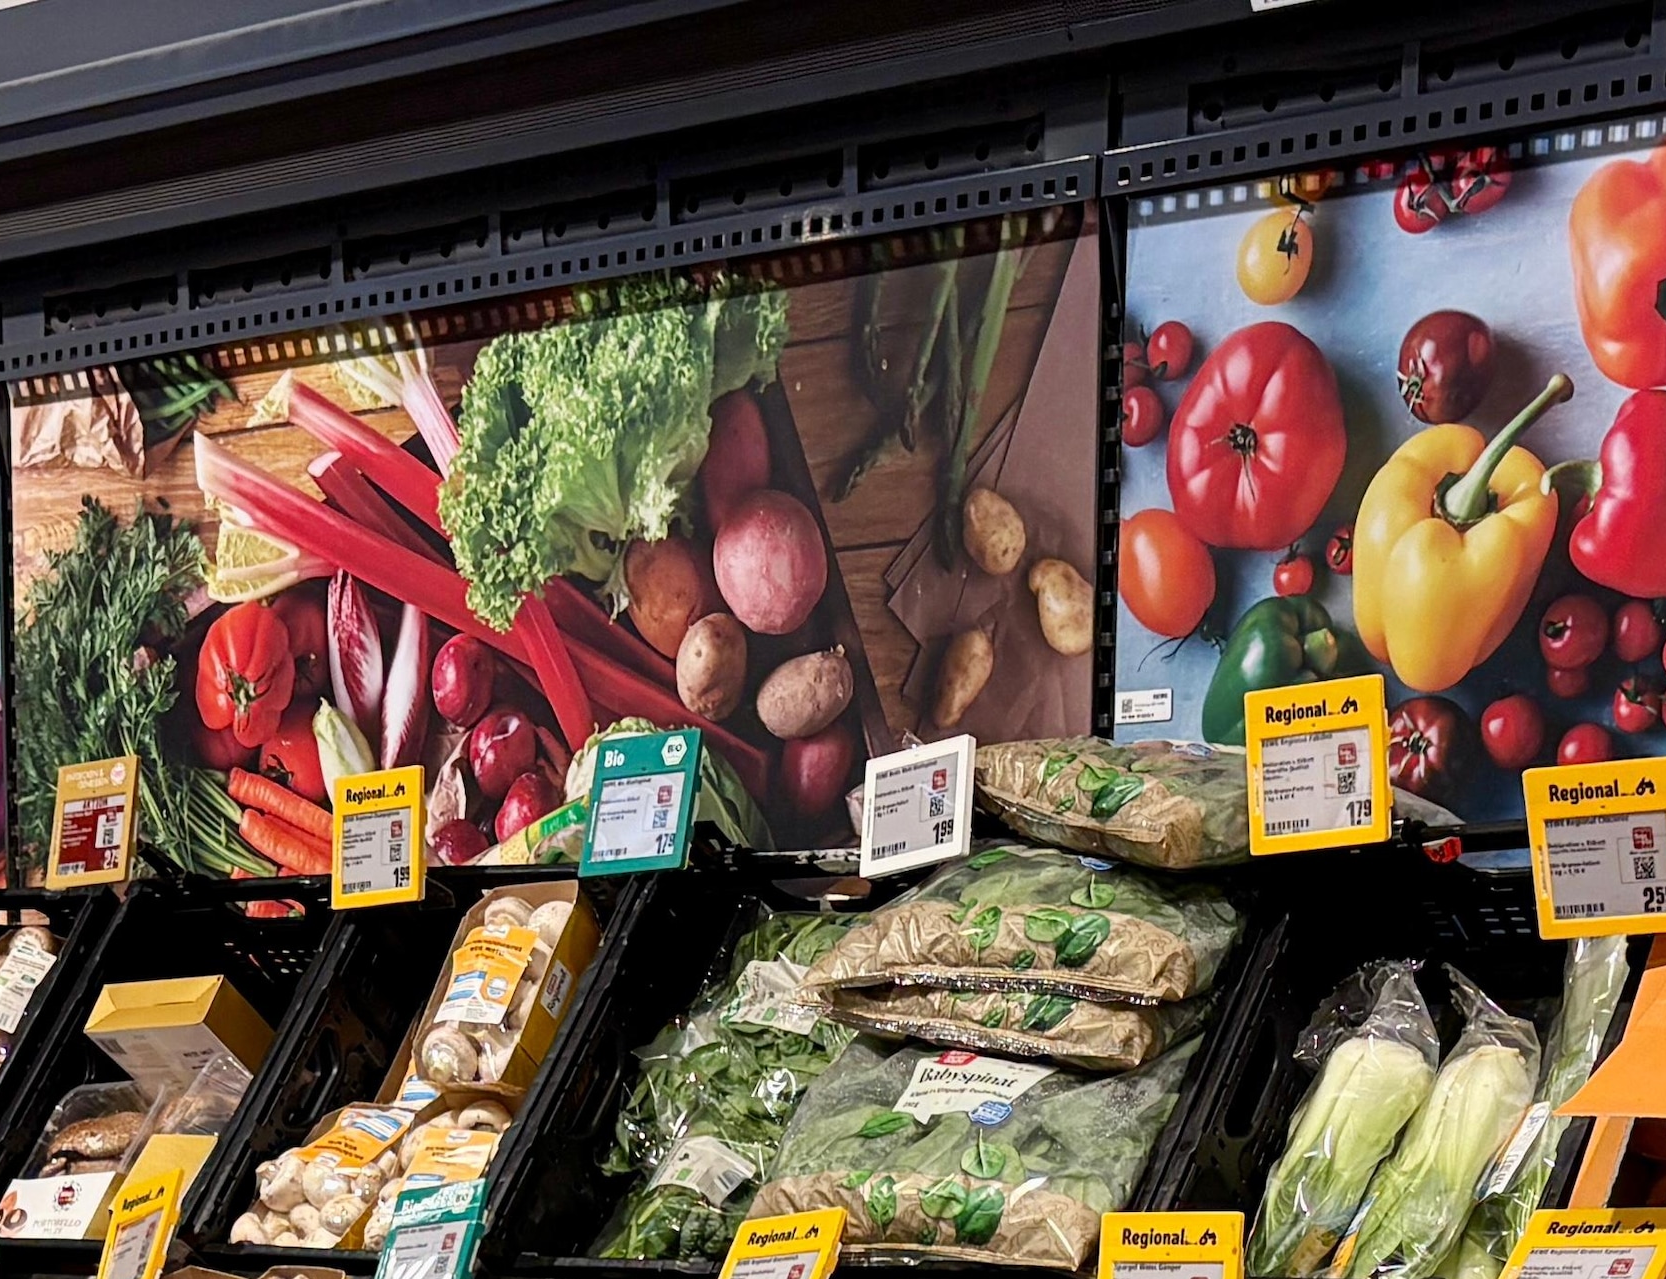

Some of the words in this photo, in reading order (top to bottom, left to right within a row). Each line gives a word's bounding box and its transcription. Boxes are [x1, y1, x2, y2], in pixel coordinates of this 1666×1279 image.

[1265, 699, 1328, 726] Regional
[603, 749, 625, 769] Bio
[345, 782, 388, 804] Regional
[1549, 778, 1619, 805] Regional
[1345, 798, 1374, 827] 1.79
[919, 1066, 1019, 1089] Babyspinat
[746, 1224, 796, 1247] Regional
[1122, 1227, 1186, 1250] Regional
[1546, 1220, 1621, 1238] Regional
